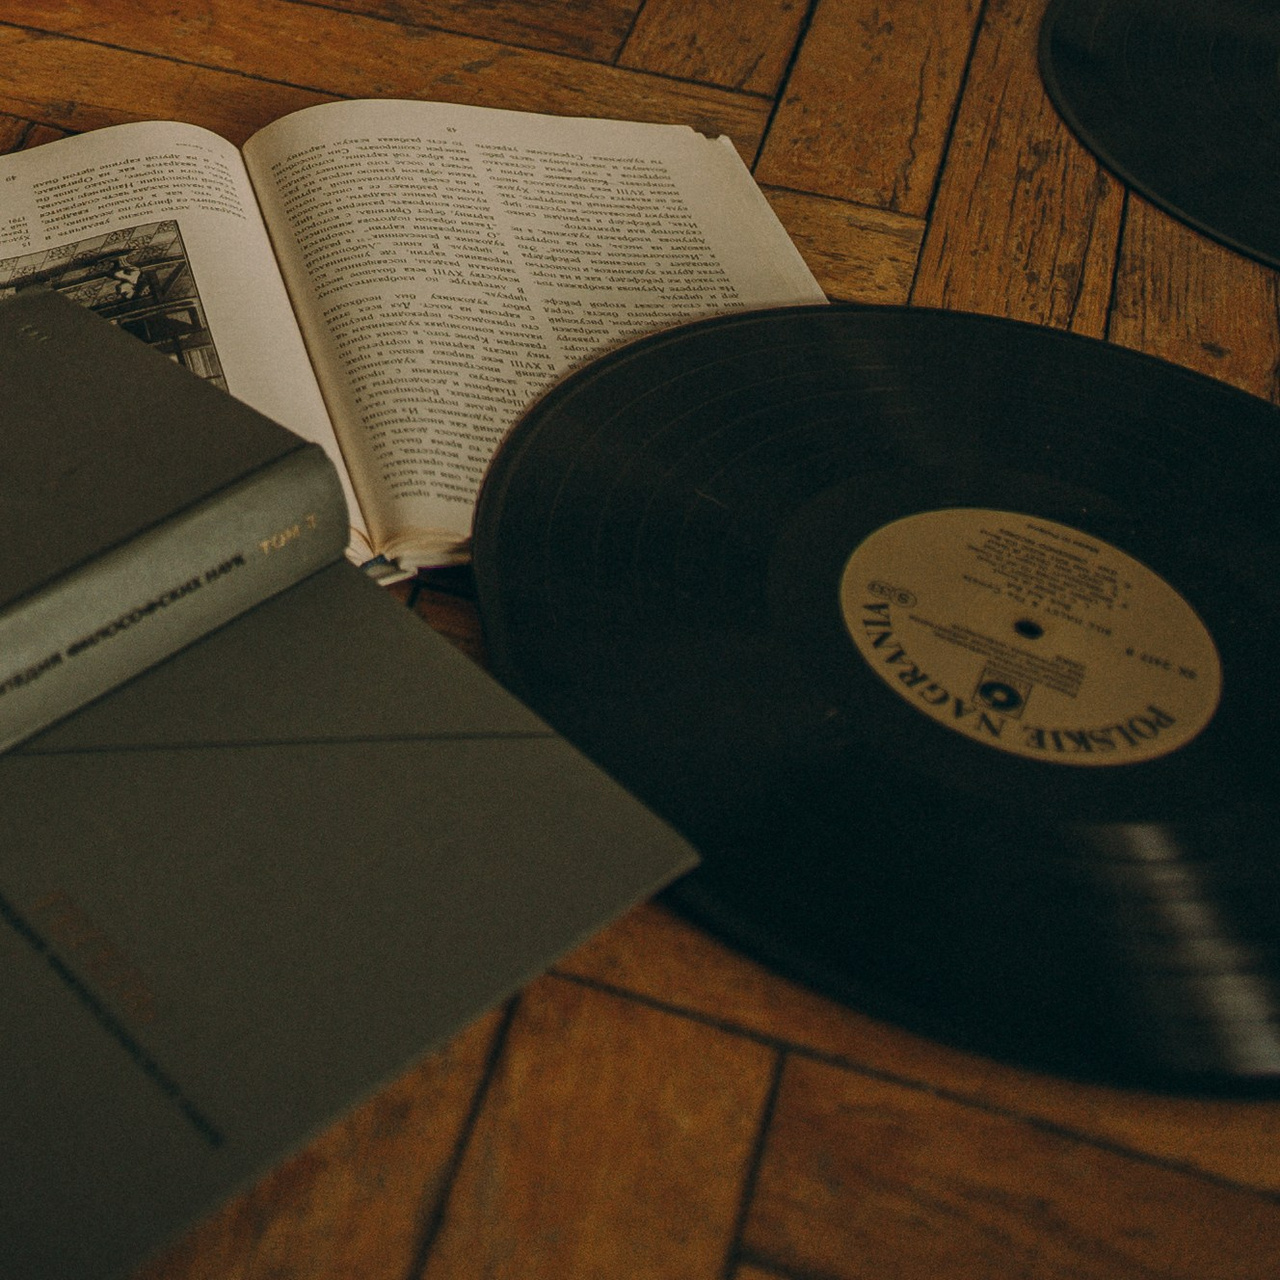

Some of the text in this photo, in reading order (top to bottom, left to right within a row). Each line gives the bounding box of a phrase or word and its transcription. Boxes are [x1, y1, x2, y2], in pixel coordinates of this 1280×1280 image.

[83, 176, 119, 189] только
[542, 213, 590, 222] карандаш
[607, 217, 662, 227] рейсфедер
[650, 227, 702, 235] скульптор
[513, 234, 559, 244] портрете
[596, 234, 651, 242] изображен
[657, 236, 705, 244] Аргунова
[517, 243, 538, 252] Это
[520, 251, 581, 263] рейсфедера
[589, 258, 646, 266] описанием
[524, 261, 581, 272] полностью
[695, 267, 725, 275] ретах
[448, 277, 506, 290] литературе
[555, 281, 613, 291] изображен
[683, 277, 714, 285] такой
[616, 284, 665, 293] Аргунова
[668, 284, 717, 292] портрете
[430, 292, 488, 305] художнику
[390, 301, 410, 309] Для
[501, 302, 532, 311] работ
[378, 310, 441, 318] переводить
[478, 308, 520, 318] картона
[328, 312, 374, 333] рисунок
[447, 313, 516, 327] приходилось
[351, 319, 420, 333] художникам
[423, 320, 494, 334] композициях
[454, 332, 489, 344] Кроме
[498, 329, 543, 340] нальных
[357, 338, 411, 352] портреты
[429, 339, 475, 350] картины
[432, 349, 474, 359] широко
[482, 346, 518, 356] писать
[509, 359, 541, 370] XVIII
[546, 363, 555, 371] В
[861, 600, 1008, 739] NAGRANIA
[1021, 704, 1177, 754] POLSKIE
